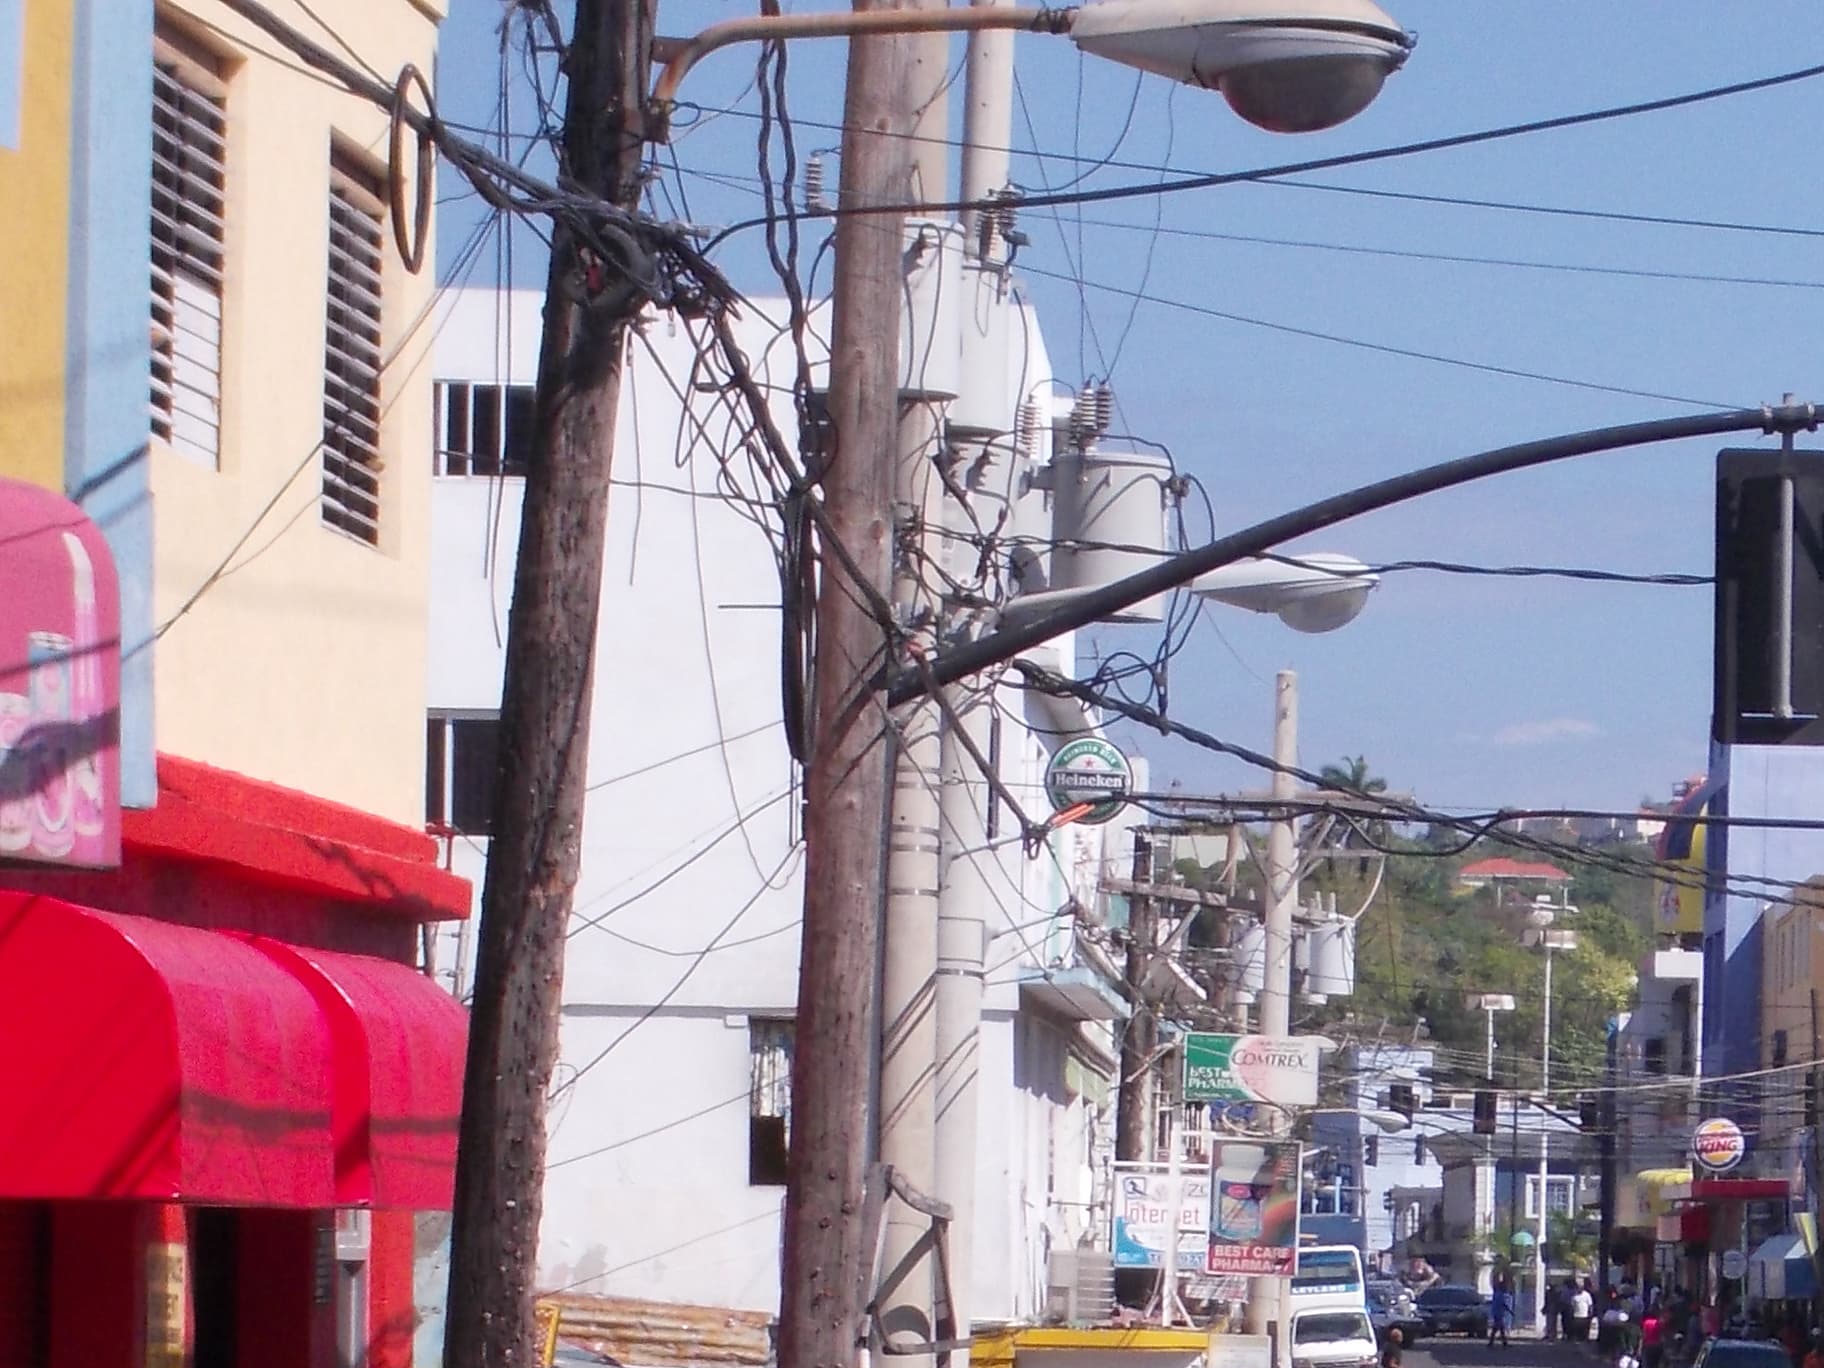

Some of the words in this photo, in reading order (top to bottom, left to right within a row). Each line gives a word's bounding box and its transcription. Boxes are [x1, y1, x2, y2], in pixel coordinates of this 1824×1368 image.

[1055, 773, 1123, 788] Heineken
[1232, 1048, 1306, 1067] COMTREX
[1124, 1199, 1200, 1226] Interet
[1214, 1245, 1250, 1257] BEST
[1252, 1246, 1290, 1259] CARE
